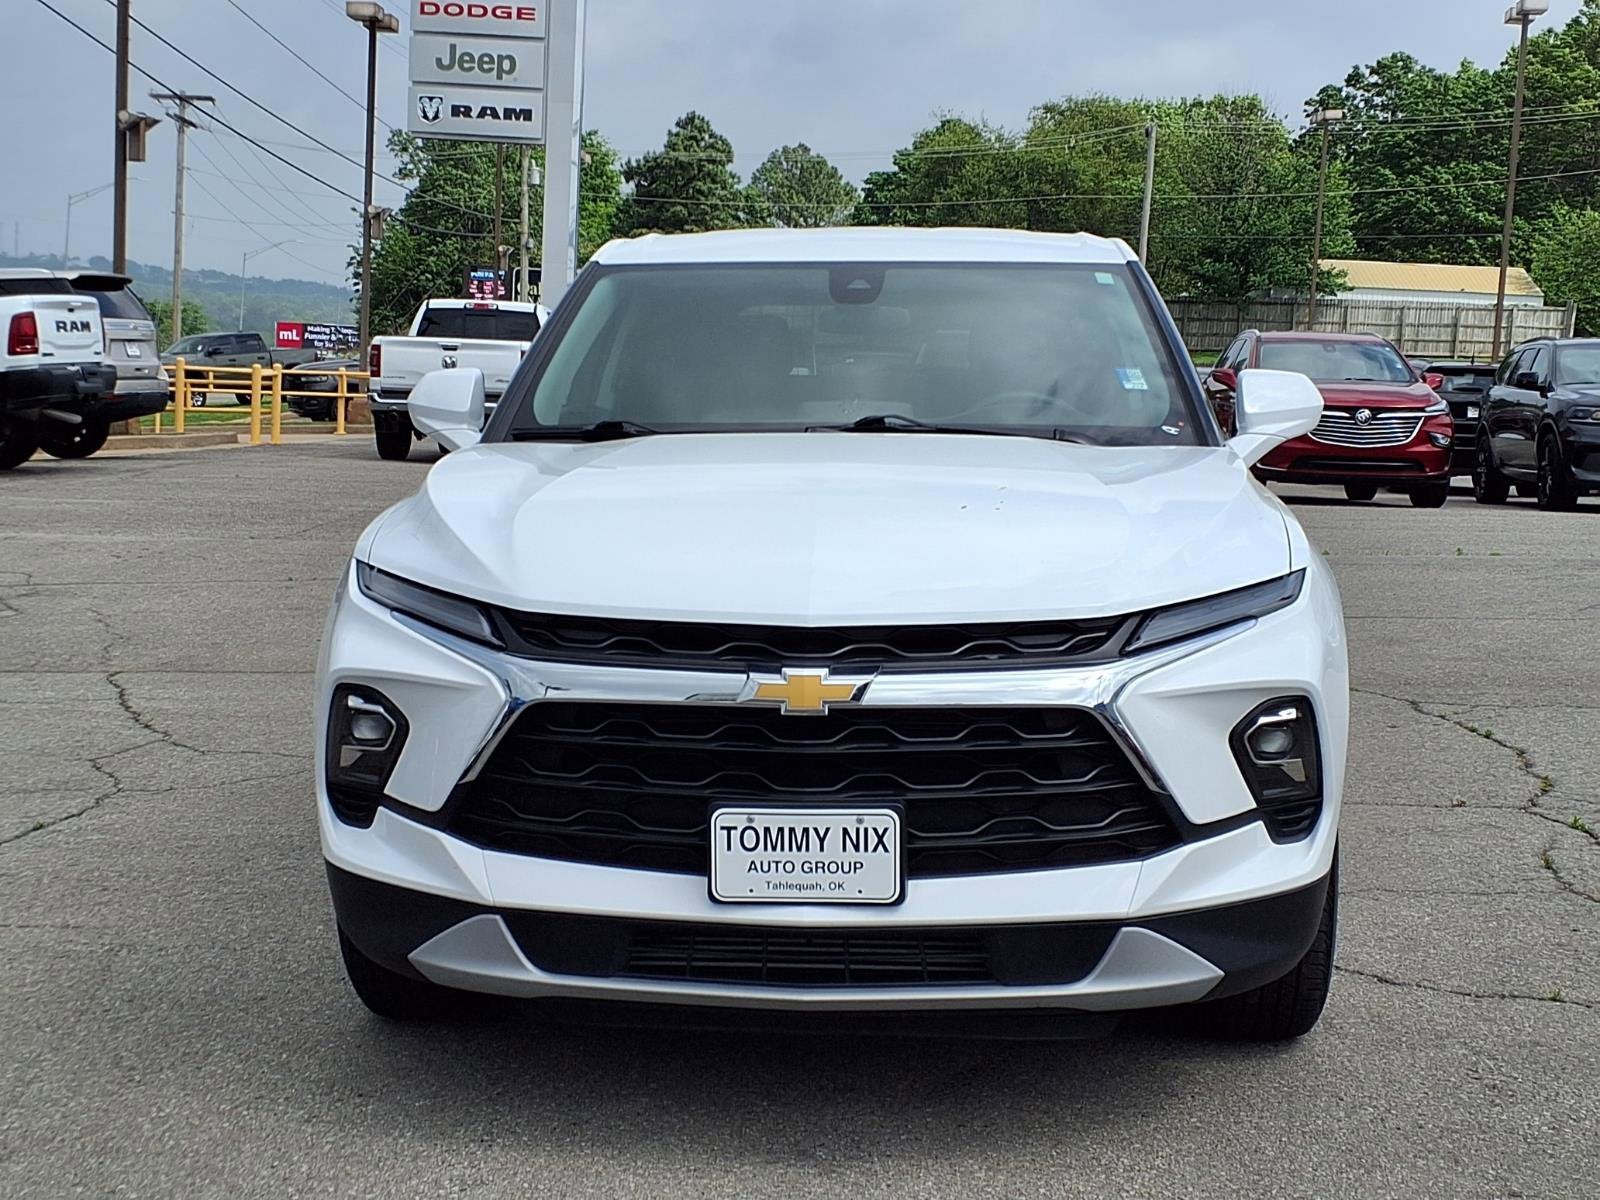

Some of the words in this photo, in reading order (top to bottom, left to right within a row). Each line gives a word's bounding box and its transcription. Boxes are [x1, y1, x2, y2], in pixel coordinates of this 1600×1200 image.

[420, 1, 537, 21] DODGE
[435, 43, 517, 80] Jeep
[450, 104, 533, 122] RAM
[55, 320, 92, 333] RAM
[307, 325, 331, 334] Making
[279, 329, 301, 341] mL
[304, 332, 331, 341] Funnier
[720, 825, 831, 853] TOMMY
[842, 826, 890, 853] NIX
[747, 860, 796, 874] AUTO
[801, 860, 864, 875] GROUP
[766, 880, 825, 892] Tahlequah,
[829, 881, 846, 891] OK
